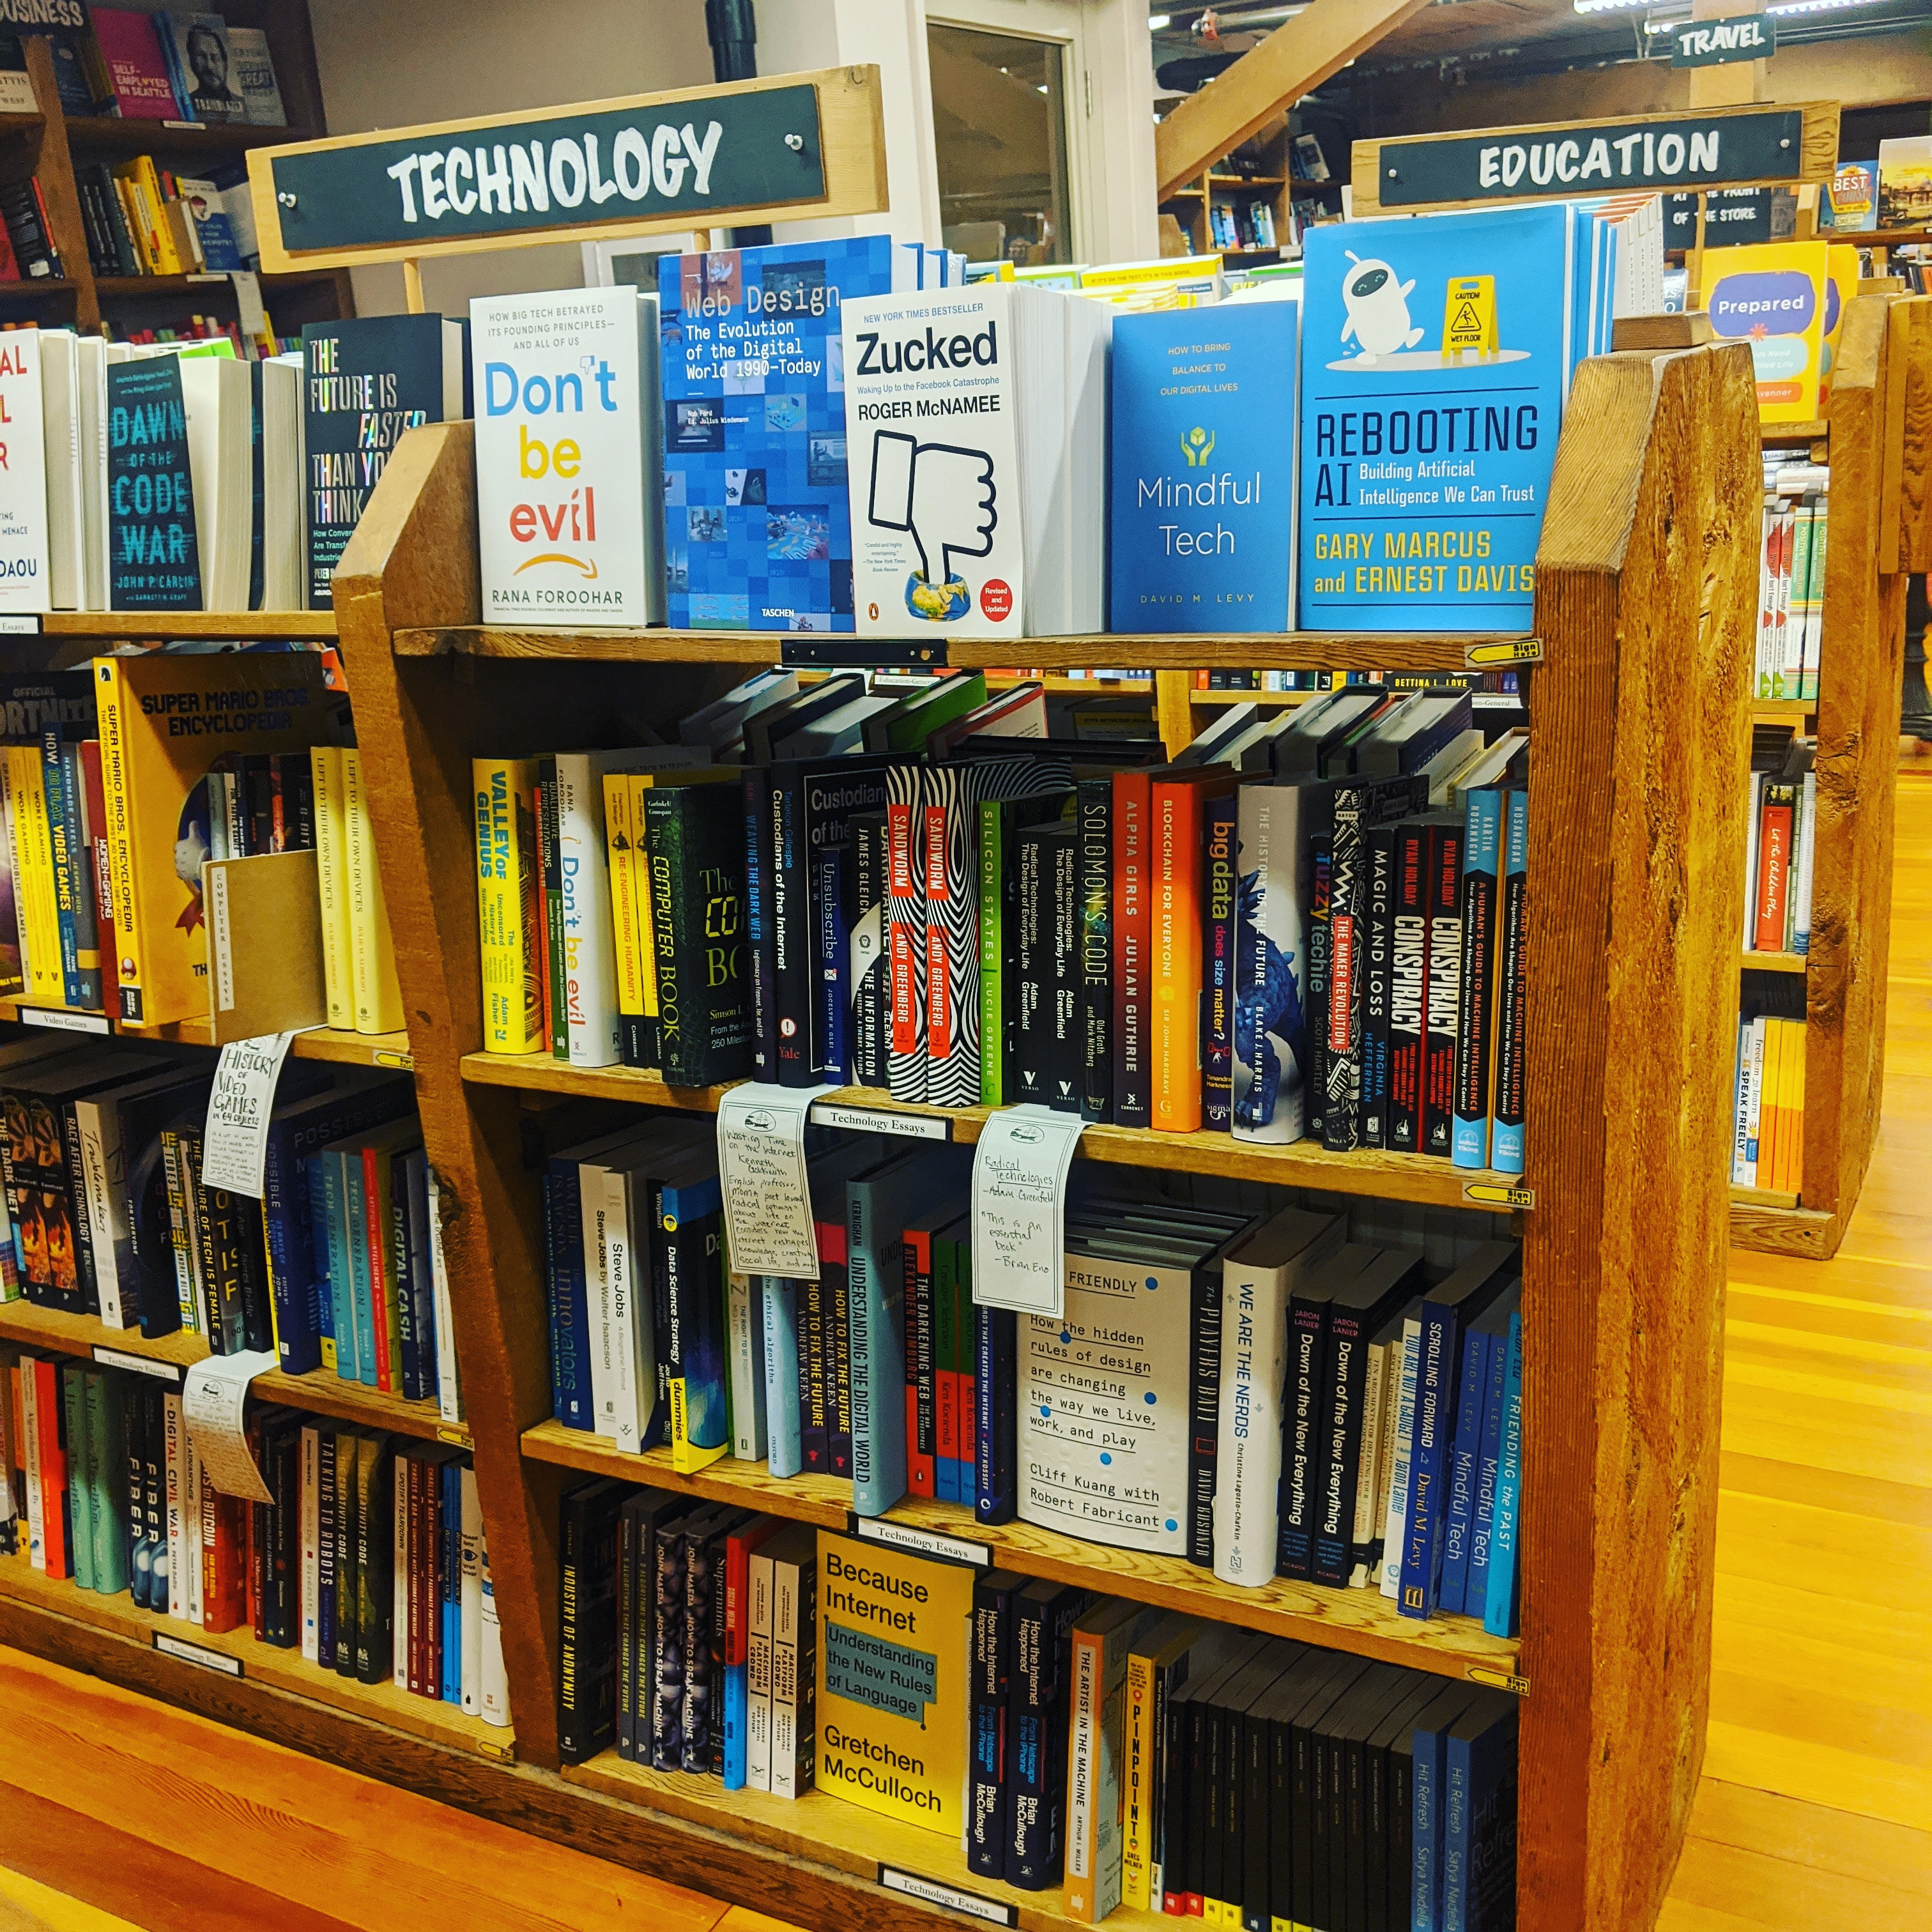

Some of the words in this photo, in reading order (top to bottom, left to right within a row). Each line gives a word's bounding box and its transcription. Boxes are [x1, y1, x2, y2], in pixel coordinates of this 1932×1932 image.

[1678, 22, 1766, 56] TRAVEL
[387, 120, 723, 222] TECHNOLOGY
[1479, 131, 1720, 188] EDUCATION
[1833, 176, 1867, 192] BEST
[1673, 212, 1689, 224] OF
[1694, 209, 1716, 222] HE
[1720, 208, 1756, 222] STORE
[489, 312, 510, 321] HOW
[512, 310, 527, 319] BIG
[530, 308, 553, 318] TECH
[556, 305, 604, 316] BETRAYED
[686, 292, 731, 318] Web
[747, 284, 839, 319] Design
[864, 314, 881, 323] NEW
[884, 312, 904, 321] YORK
[907, 309, 929, 319] TIMES
[931, 303, 983, 316] BESTSELLER
[1719, 296, 1804, 314] Prepared
[488, 328, 502, 337] ITS
[504, 324, 550, 335] FOUNDING
[514, 340, 532, 349] AND
[535, 339, 550, 348] ALL
[553, 338, 565, 346] OF
[567, 337, 579, 346] US
[686, 325, 710, 341] The
[719, 321, 794, 338] Evolution
[856, 321, 998, 375] Zucked
[1465, 334, 1481, 342] FLOOR
[309, 338, 339, 374] THE
[686, 345, 702, 360] of
[710, 343, 735, 358] the
[744, 339, 803, 359] Digital
[1168, 346, 1188, 355] HOW
[1192, 345, 1202, 353] TO
[1204, 343, 1230, 352] BRING
[687, 363, 727, 380] World
[857, 384, 882, 395] Waking
[883, 384, 893, 392] Up
[916, 379, 951, 389] Facebook
[953, 376, 999, 387] Catastrophe
[1172, 365, 1211, 375] BALANCE
[310, 375, 373, 413] FUTURE
[379, 374, 397, 408] IS
[1180, 385, 1211, 394] DIGITAL
[1215, 383, 1238, 392] LIVES
[114, 399, 185, 447] DAWN
[858, 401, 912, 420] ROGER
[916, 395, 1000, 417] McNAMEE
[1317, 406, 1538, 457] REBOOTING
[128, 454, 145, 466] OF
[151, 452, 172, 465] THE
[312, 452, 355, 487] THAN
[520, 425, 581, 479] be
[1315, 463, 1352, 507] AI
[1359, 461, 1413, 482] Building
[1417, 460, 1475, 478] Artificial
[114, 472, 188, 516] CODE
[312, 489, 364, 523] THINK
[1138, 471, 1260, 508] Mindful
[1359, 488, 1439, 507] Intelligence
[1444, 488, 1466, 503] We
[1471, 486, 1496, 502] Can
[1500, 484, 1534, 502] Trust
[510, 487, 595, 542] evil
[122, 524, 185, 565] WAR
[1159, 523, 1235, 555] Tech
[1315, 533, 1374, 560] GARY
[1384, 531, 1491, 558] MARCUS
[493, 590, 530, 603] RANA
[537, 590, 623, 604] FOROOHAR
[1314, 572, 1345, 594] and
[1355, 565, 1448, 593] ERNEST
[1457, 564, 1534, 592] DAVIS
[762, 608, 794, 617] TASCHEN
[1140, 594, 1183, 603] DAVID
[1216, 594, 1255, 602] LEVY
[1513, 644, 1536, 653] Sign
[107, 705, 118, 746] SUPER
[111, 750, 121, 792] MARIO
[115, 795, 126, 836] BROS.
[491, 770, 508, 861] VALLEY
[772, 789, 783, 870] Custodians
[1126, 801, 1137, 857] ALPHA
[477, 792, 493, 878] GENIUS
[652, 826, 660, 848] The
[894, 815, 908, 887] SANDWORM
[985, 811, 993, 884] SILICON
[1163, 799, 1172, 882] BLOCKCHAIN
[119, 839, 133, 933] ENCYCLOPEDIA
[775, 874, 783, 887] of
[1126, 865, 1137, 916] GIRLS
[1163, 885, 1172, 901] FOR
[1373, 850, 1388, 913] MAGIC
[618, 856, 632, 942] RE-ENGINEERING
[654, 856, 674, 957] COMPUTER
[776, 891, 785, 914] the
[776, 917, 786, 970] Internet
[985, 896, 993, 960] STATES
[1162, 905, 1172, 978] EVERYONE
[1371, 921, 1384, 962] AND
[621, 945, 636, 1001] HUMANITY
[1391, 916, 1420, 1035] CONSPIRACY
[660, 964, 680, 1041] BOOK
[1370, 971, 1382, 1016] LOSS
[44, 1015, 62, 1025] Video
[224, 1049, 277, 1078] HISTORY
[214, 1094, 257, 1114] GAMES
[1740, 1071, 1749, 1106] SPEAK
[830, 1113, 889, 1130] Technology
[891, 1119, 925, 1134] Essays
[1738, 1111, 1747, 1150] FREELY
[985, 1156, 1019, 1169] Radical
[992, 1170, 1052, 1190] Technologies
[1069, 1271, 1137, 1293] FRIENDLY
[1239, 1283, 1254, 1310] WE
[851, 1257, 868, 1361] UNDERSTANDING
[1239, 1314, 1252, 1347] ARE
[854, 1363, 868, 1387] THE
[1031, 1342, 1068, 1358] rules
[1077, 1349, 1092, 1362] of
[1100, 1353, 1151, 1372] design
[1237, 1349, 1251, 1381] THE
[854, 1388, 869, 1435] DIGITAL
[1234, 1384, 1250, 1439] NERDS
[167, 1409, 177, 1462] DIGITAL
[855, 1439, 870, 1483] WORLD
[169, 1469, 177, 1503] CIVIL
[1031, 1463, 1066, 1483] Cliff
[1075, 1475, 1116, 1497] Kuang
[1124, 1486, 1160, 1501] with
[169, 1509, 179, 1538] WAR
[1031, 1488, 1074, 1510] Robert
[1083, 1503, 1160, 1527] Fabricant
[877, 1528, 933, 1551] Technology
[936, 1541, 969, 1558] Essays
[827, 1552, 928, 1603] Because
[825, 1586, 916, 1634] Internet
[827, 1628, 935, 1675] Understanding
[827, 1650, 850, 1672] the
[853, 1658, 885, 1679] New
[890, 1668, 932, 1696] Rules
[827, 1673, 842, 1689] of
[845, 1679, 917, 1713] Language
[825, 1725, 924, 1777] Gretchen
[825, 1755, 941, 1813] McCulloch
[1130, 1705, 1141, 1836] PINPOINT
[902, 1879, 955, 1904] Technology
[958, 1896, 989, 1915] Essays
